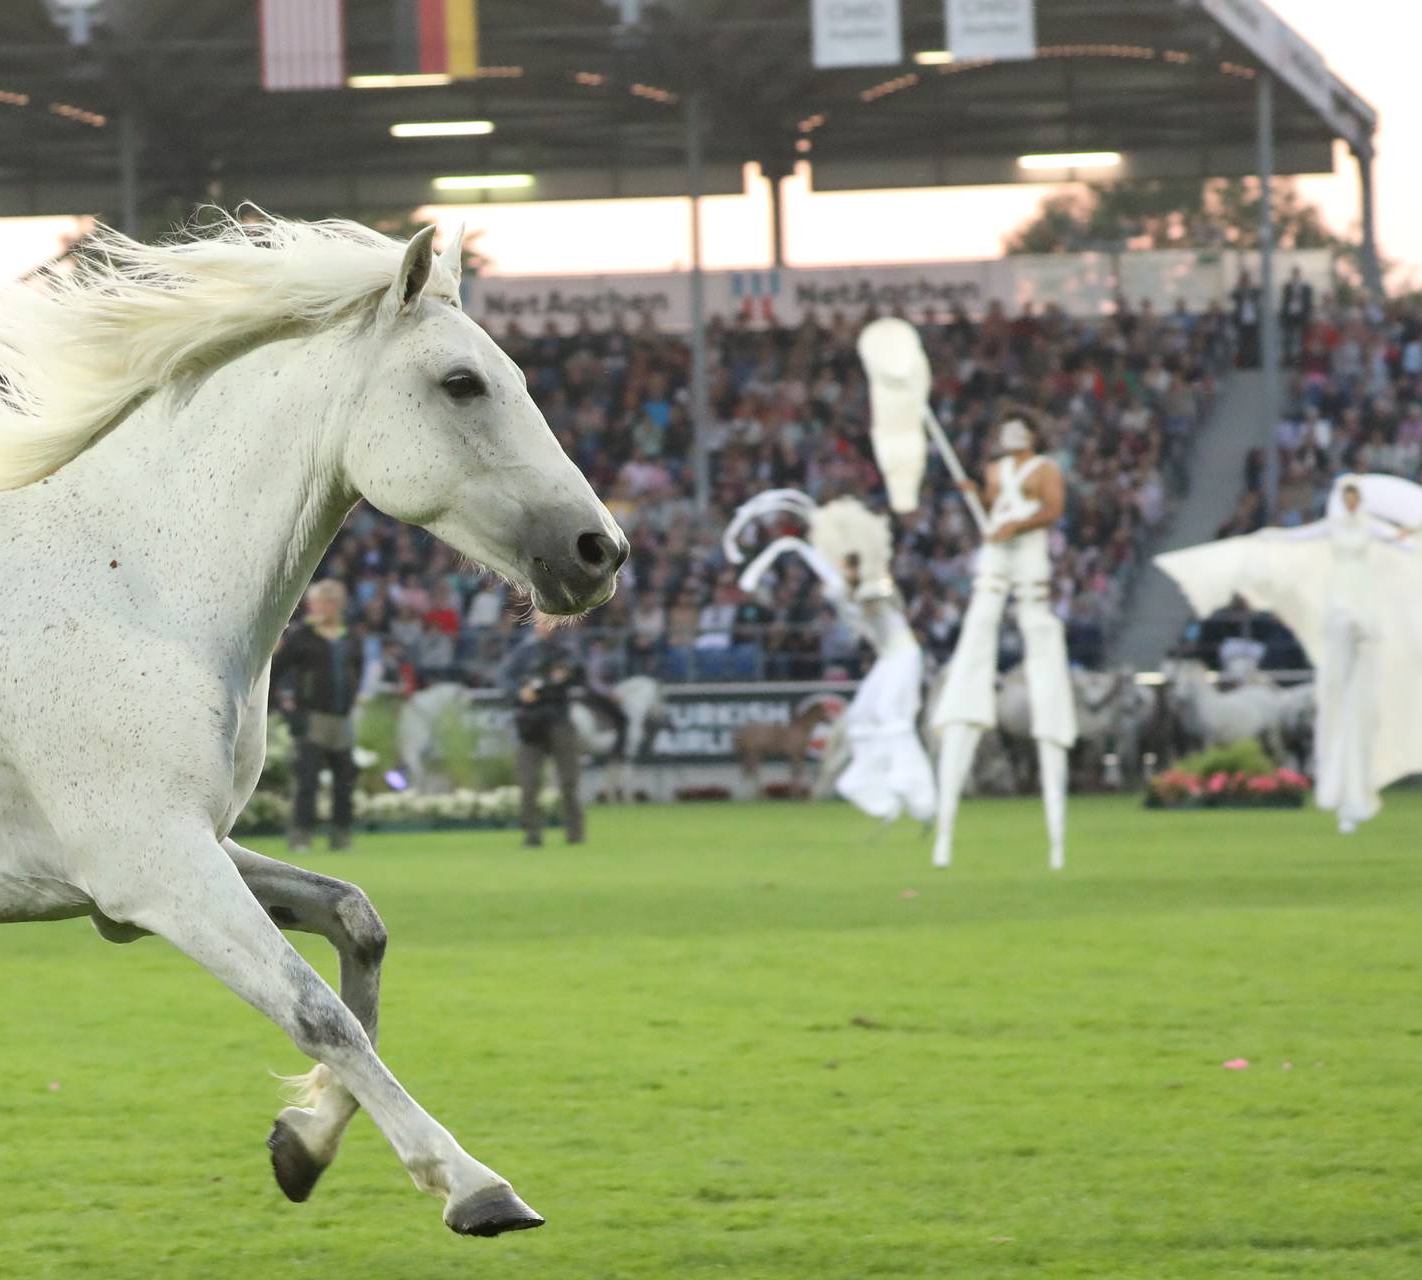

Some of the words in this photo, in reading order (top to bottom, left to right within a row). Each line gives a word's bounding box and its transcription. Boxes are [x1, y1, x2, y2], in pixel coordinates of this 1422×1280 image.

[484, 287, 669, 315] NetAachen
[795, 277, 980, 305] NetAachen
[652, 727, 734, 754] AIRLI
